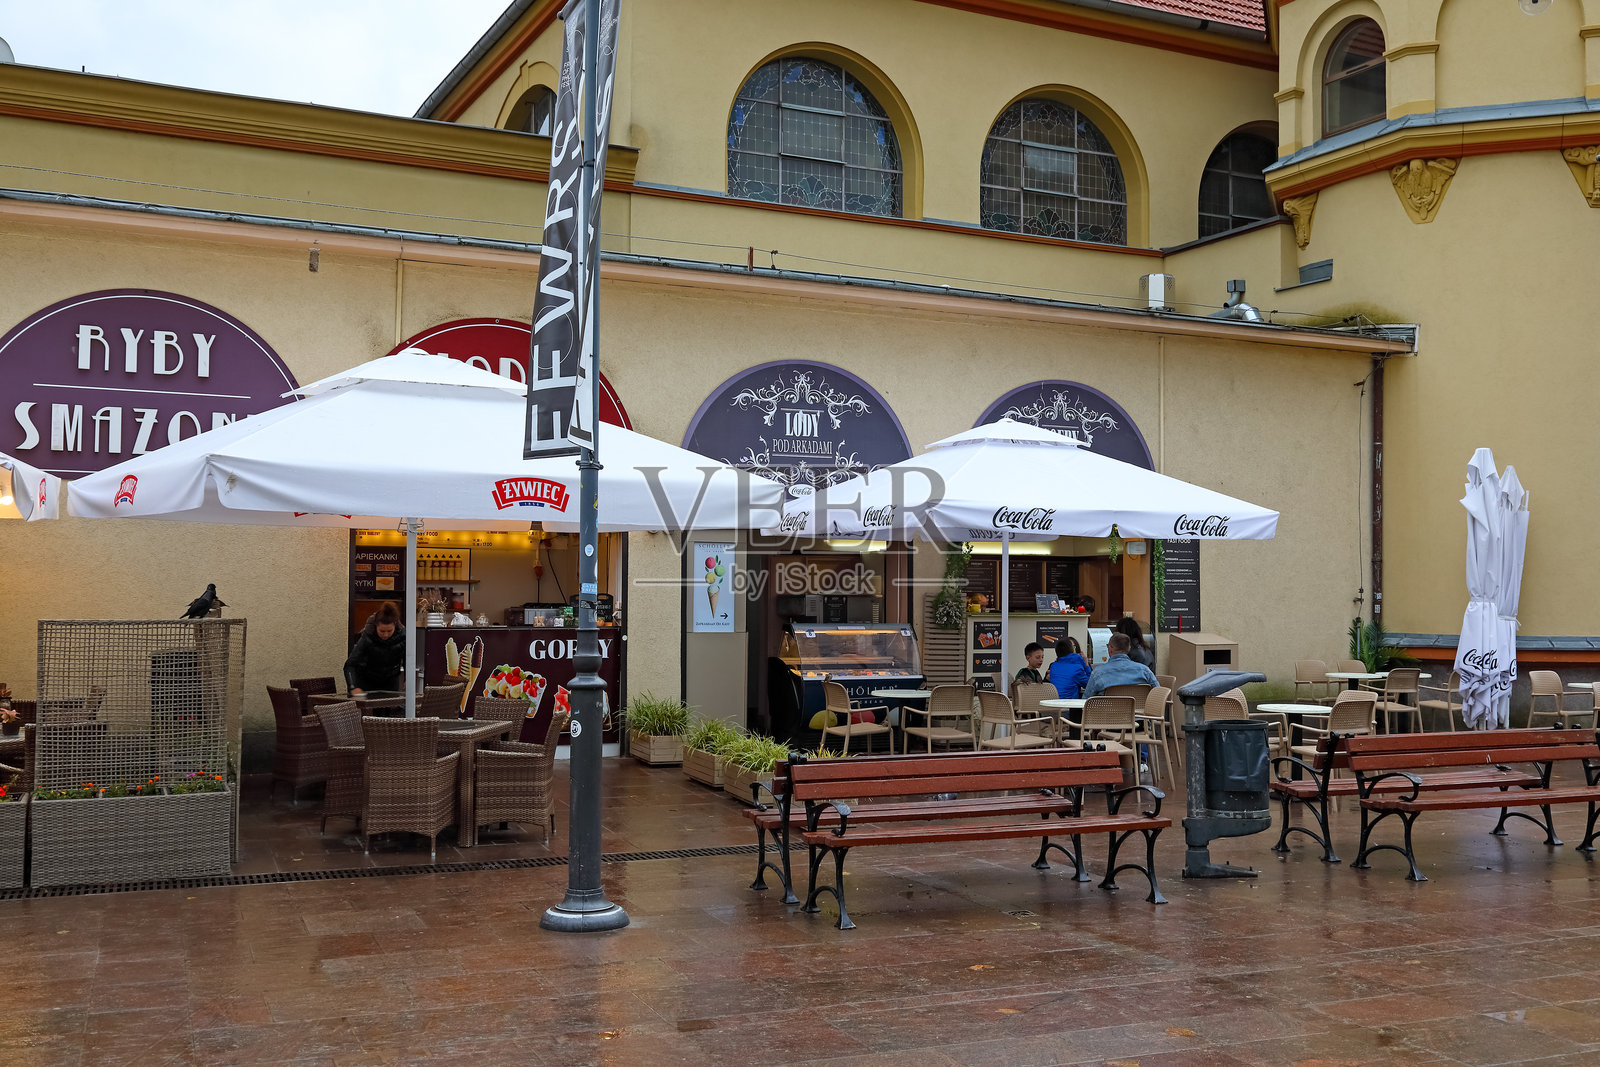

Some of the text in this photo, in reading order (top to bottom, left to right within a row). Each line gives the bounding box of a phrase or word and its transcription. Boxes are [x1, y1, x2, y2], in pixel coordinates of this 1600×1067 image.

[76, 324, 216, 378] RYBY
[14, 401, 256, 456] SMAZO
[784, 410, 821, 438] LODY
[772, 438, 833, 455] POD ARKADAMI
[501, 480, 560, 502] ŻYWIEC
[529, 638, 613, 660] GOFY
